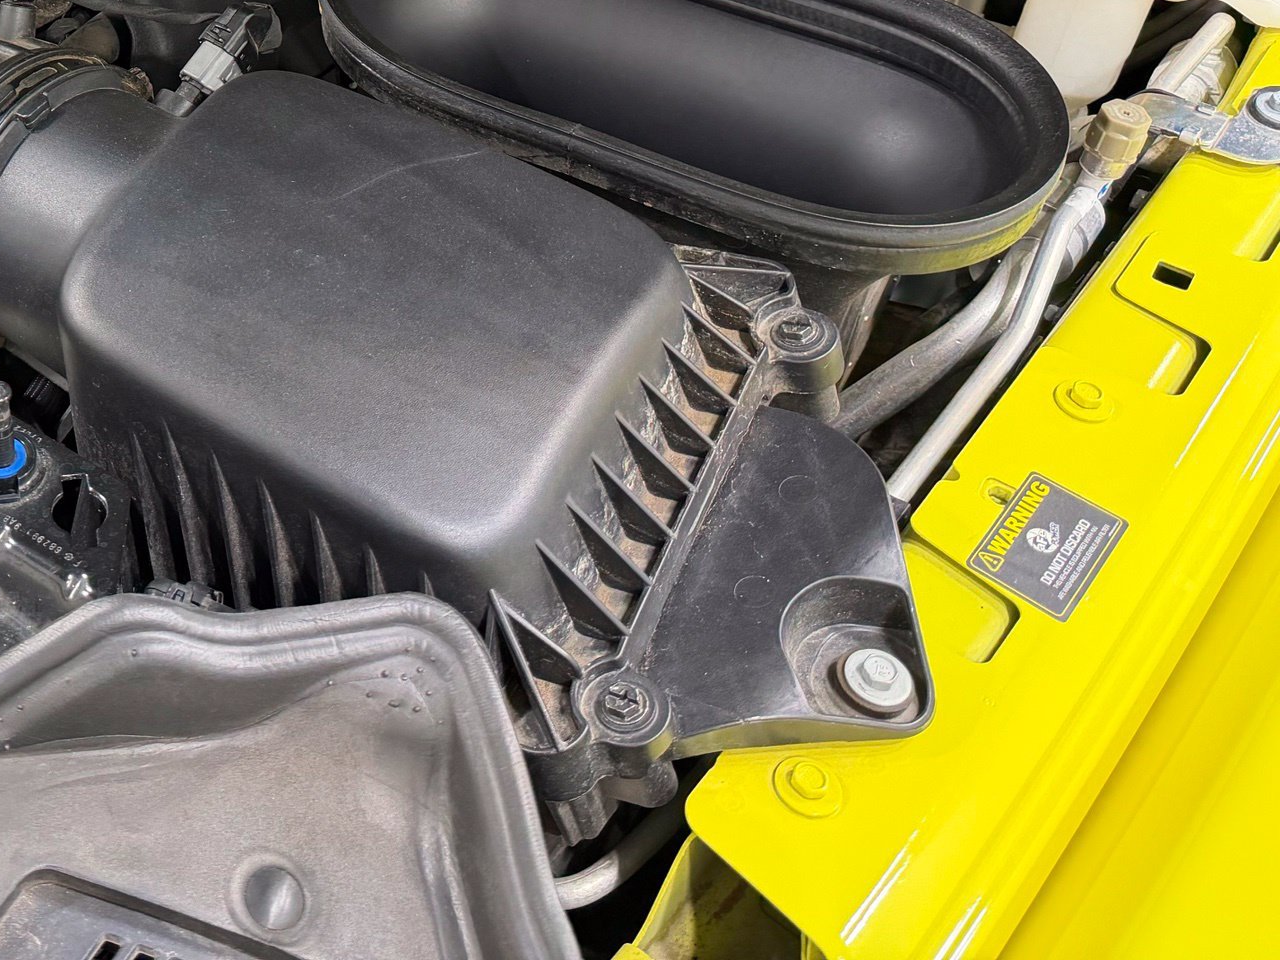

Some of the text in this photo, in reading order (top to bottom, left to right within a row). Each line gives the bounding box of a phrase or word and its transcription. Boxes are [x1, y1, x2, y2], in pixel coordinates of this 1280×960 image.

[987, 479, 1051, 557] WARNING
[1040, 518, 1091, 586] DO NOT DISCARD
